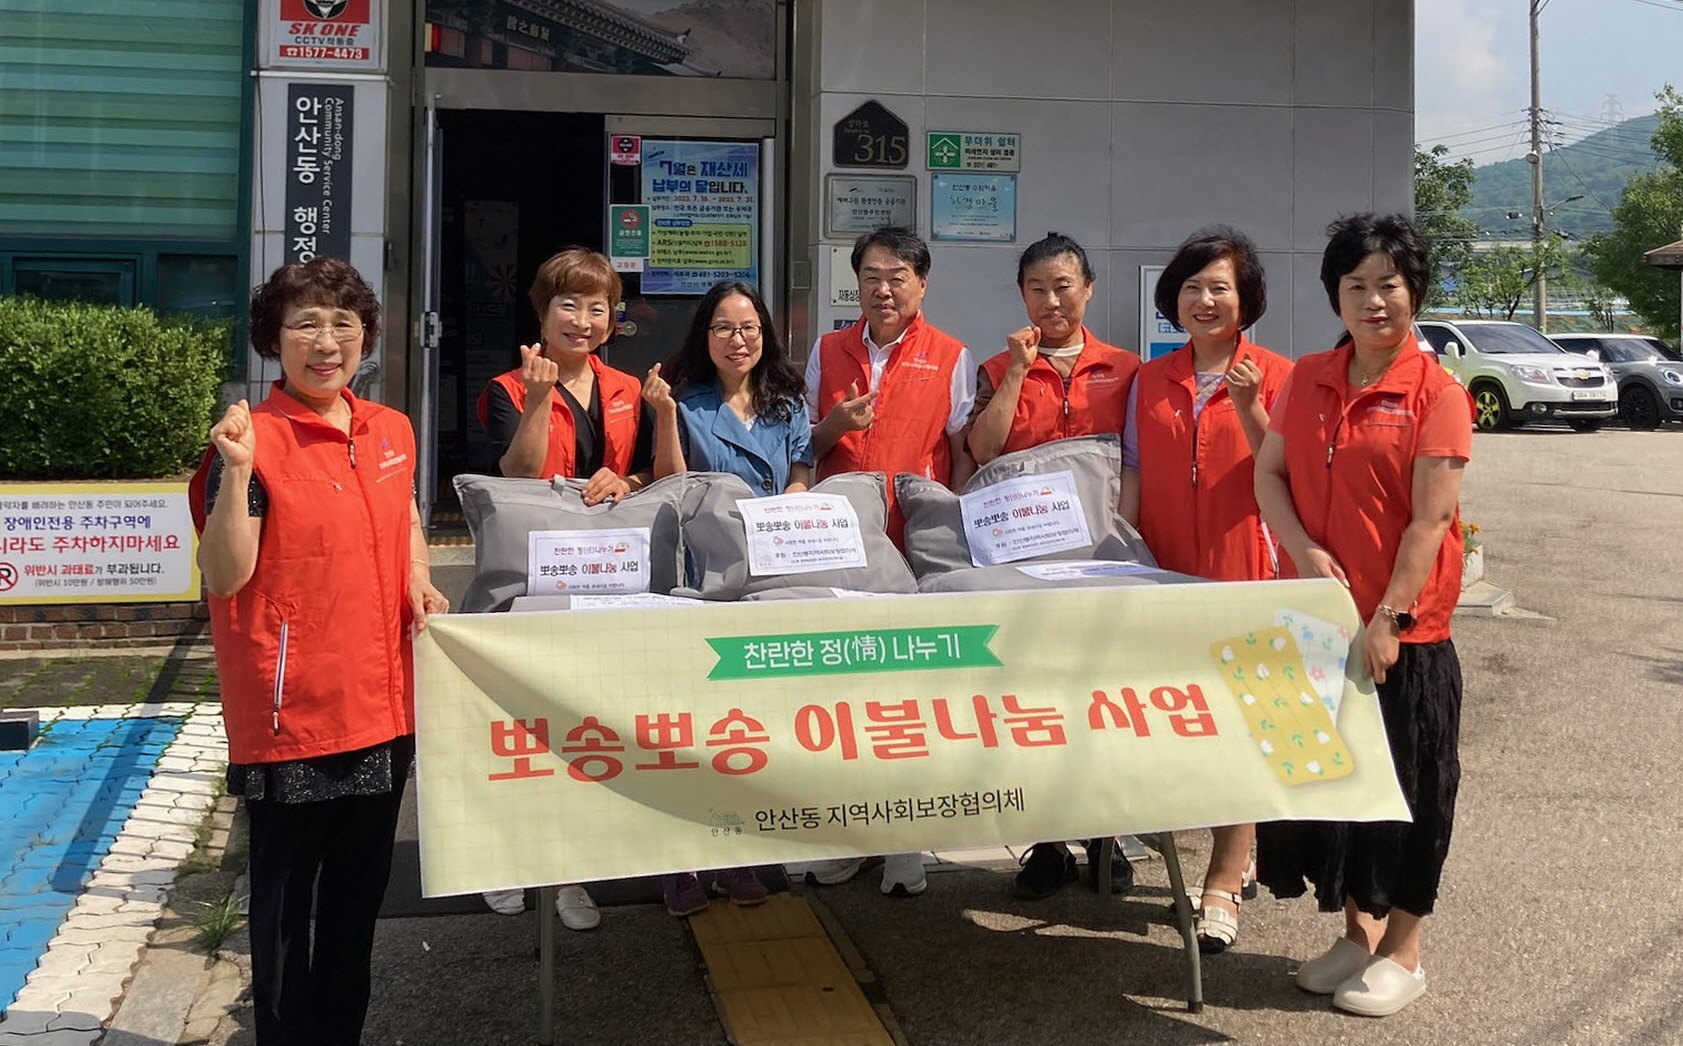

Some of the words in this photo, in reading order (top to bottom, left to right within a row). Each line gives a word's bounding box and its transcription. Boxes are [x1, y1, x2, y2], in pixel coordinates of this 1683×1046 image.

[289, 23, 317, 34] SK
[320, 24, 360, 36] ONE
[299, 48, 362, 59] 1577-4473
[324, 98, 334, 158] Community
[333, 98, 344, 161] Ansan-dong
[293, 97, 322, 184] 안산동
[854, 134, 906, 163] 315
[965, 136, 992, 146] 무더위
[998, 137, 1015, 146] 쉼터
[323, 160, 333, 196] Service
[660, 160, 696, 176] 7월은
[700, 161, 748, 178] 재산세
[652, 179, 691, 192] 납부의
[695, 180, 749, 194] 달입니다.
[322, 199, 332, 234] Center
[0, 501, 28, 510] 약자를
[97, 500, 121, 509] 주민이
[124, 500, 168, 508] 되어주세요.
[974, 511, 1009, 528] 뽀송뽀송
[1012, 504, 1048, 518] 이불나눔
[1052, 500, 1070, 511] 사업
[4, 516, 75, 531] 장애인전용
[80, 516, 151, 530] 주차구역에
[756, 521, 791, 532] 뽀송뽀송
[794, 519, 828, 530] 이불나눔
[832, 518, 848, 528] 사업
[53, 535, 181, 553] 주차하지마세요
[24, 565, 57, 576] 위반시
[61, 564, 103, 575] 과태료가
[107, 563, 164, 575] 부과됩니다.
[540, 564, 578, 576] 뽀송뽀송
[581, 563, 617, 575] 이불나눔
[620, 561, 638, 572] 사업
[35, 578, 60, 588] (위반시
[744, 641, 814, 670] 찬란한
[820, 636, 886, 665] 정(情)
[892, 634, 961, 660] 나누기
[488, 708, 770, 782] 뽀송뽀송
[794, 694, 1067, 761] 이불나눔
[1088, 683, 1218, 738] 사업
[754, 806, 821, 831] 안산동
[827, 787, 1026, 827] 지역사회보장협의체
